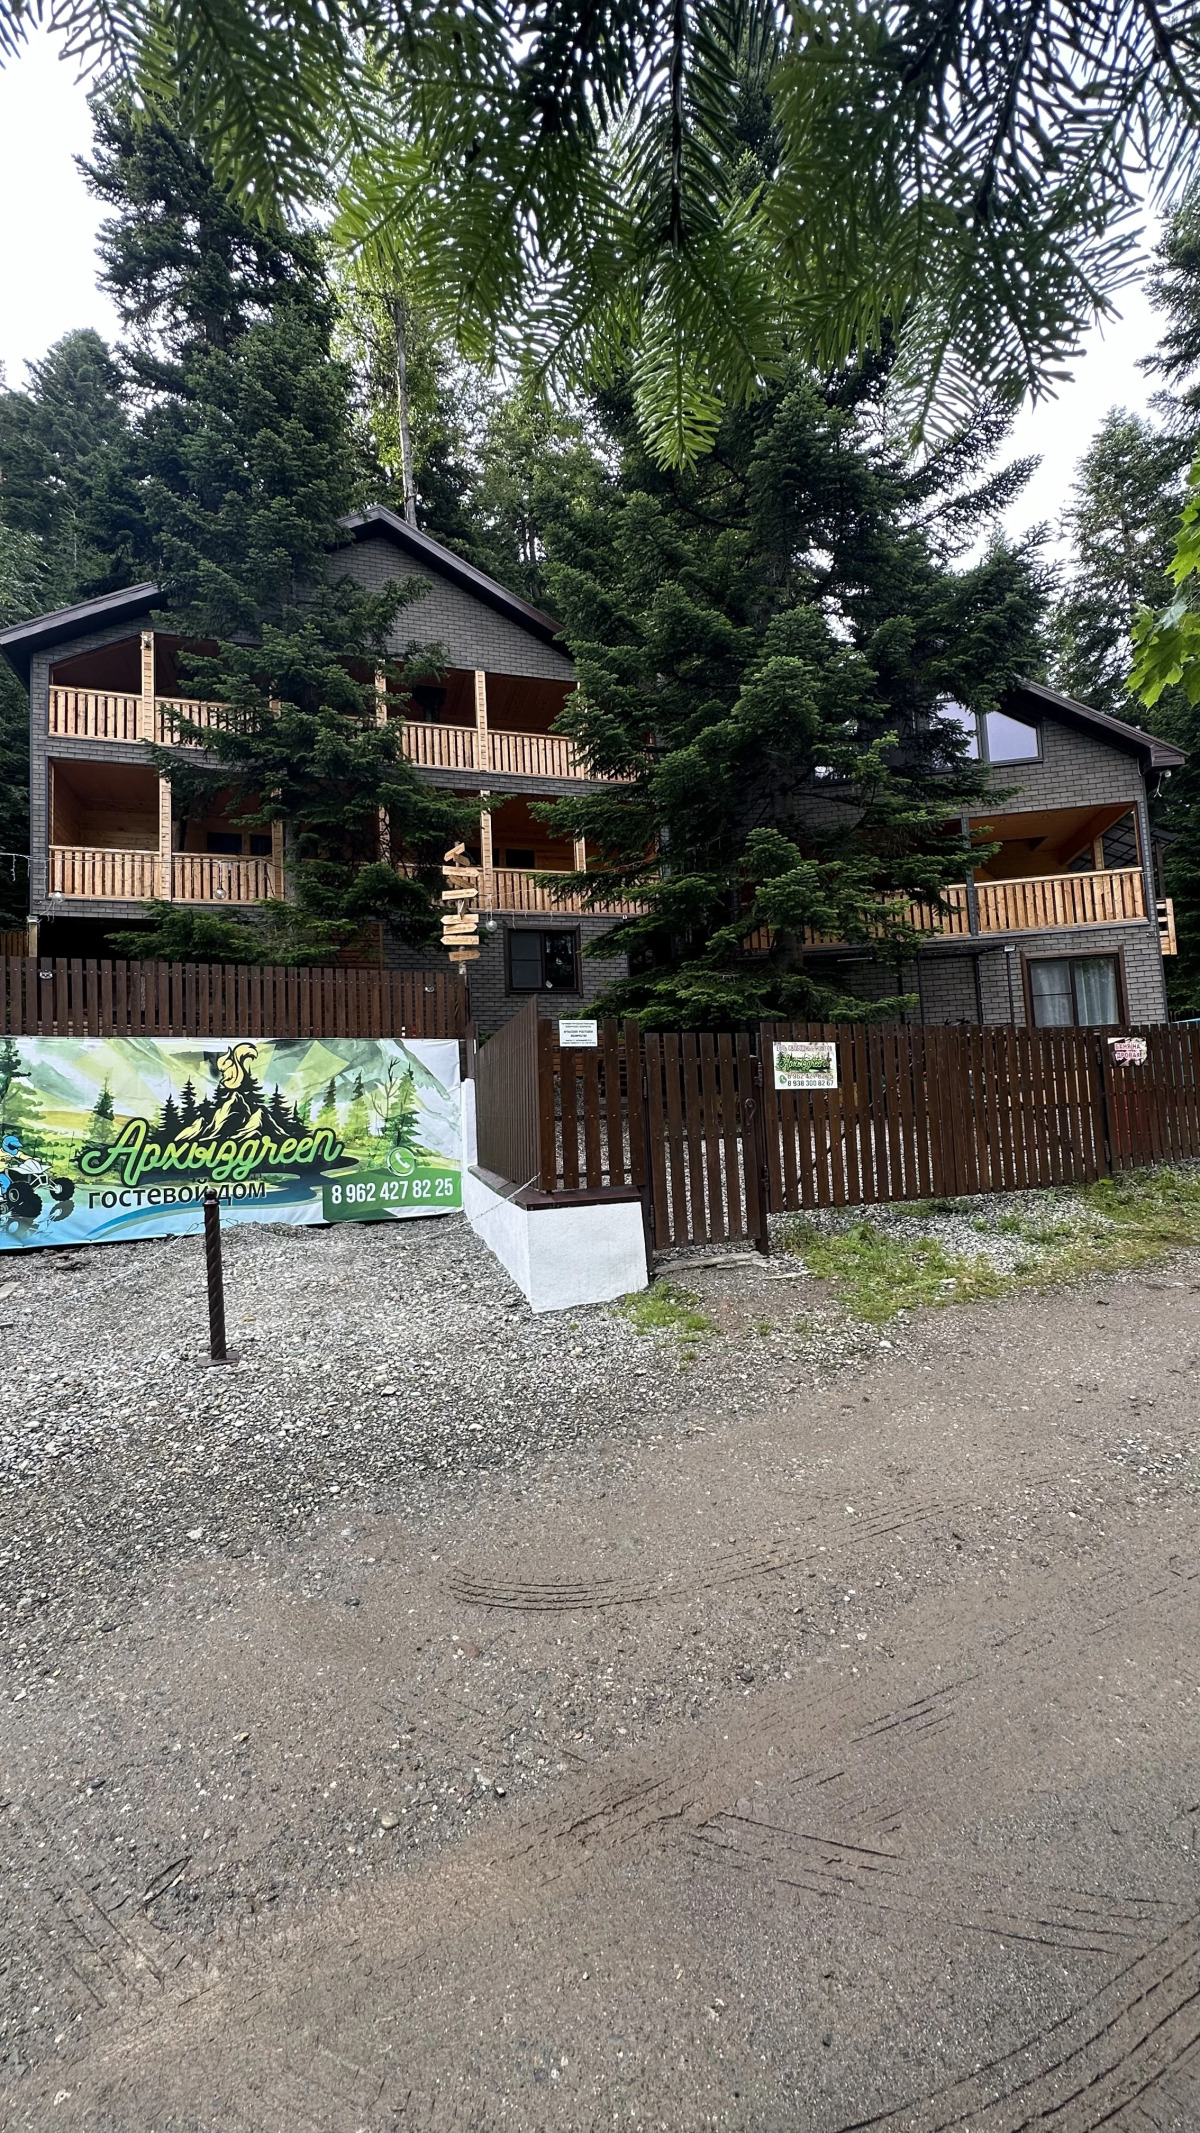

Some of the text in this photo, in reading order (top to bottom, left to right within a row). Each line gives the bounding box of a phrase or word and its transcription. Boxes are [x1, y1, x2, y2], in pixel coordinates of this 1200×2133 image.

[81, 1119, 342, 1187] Архызgreen
[217, 1182, 266, 1206] дом
[331, 1178, 454, 1204] 8 962 427 82 25
